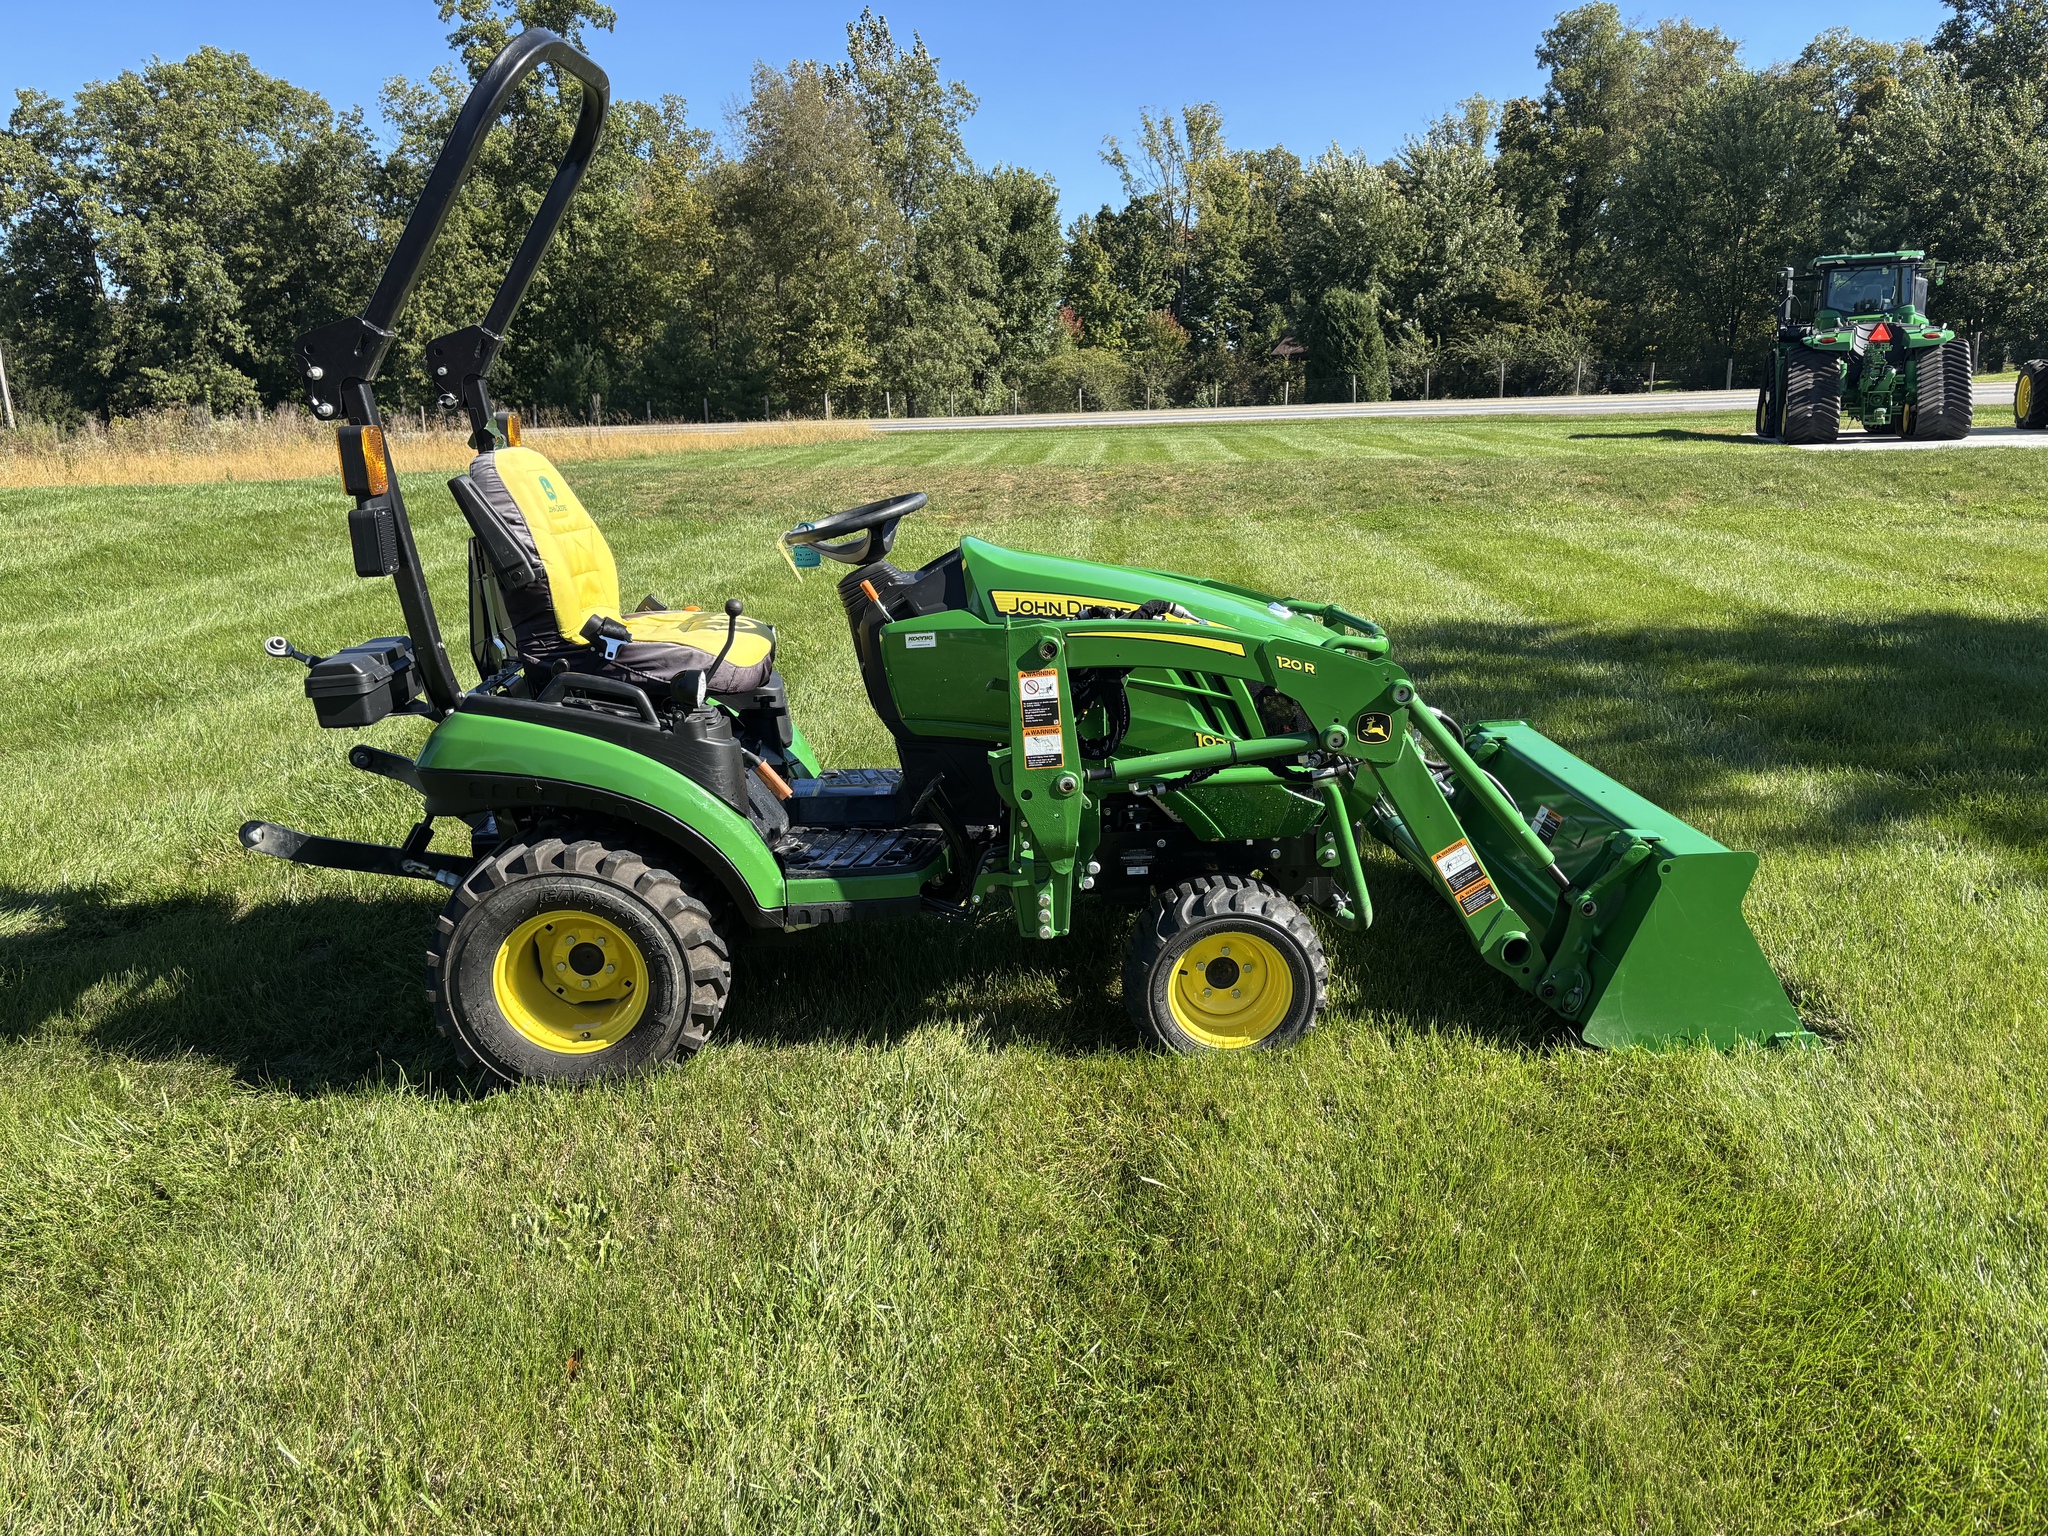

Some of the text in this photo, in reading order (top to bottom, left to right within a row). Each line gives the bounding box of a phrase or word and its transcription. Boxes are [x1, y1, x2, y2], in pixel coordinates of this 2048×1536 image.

[1009, 597, 1062, 615] JOHN
[1275, 655, 1317, 675] 120 R
[1025, 669, 1056, 678] WARNING
[1440, 841, 1463, 856] WARNING
[1465, 881, 1487, 896] WARNING
